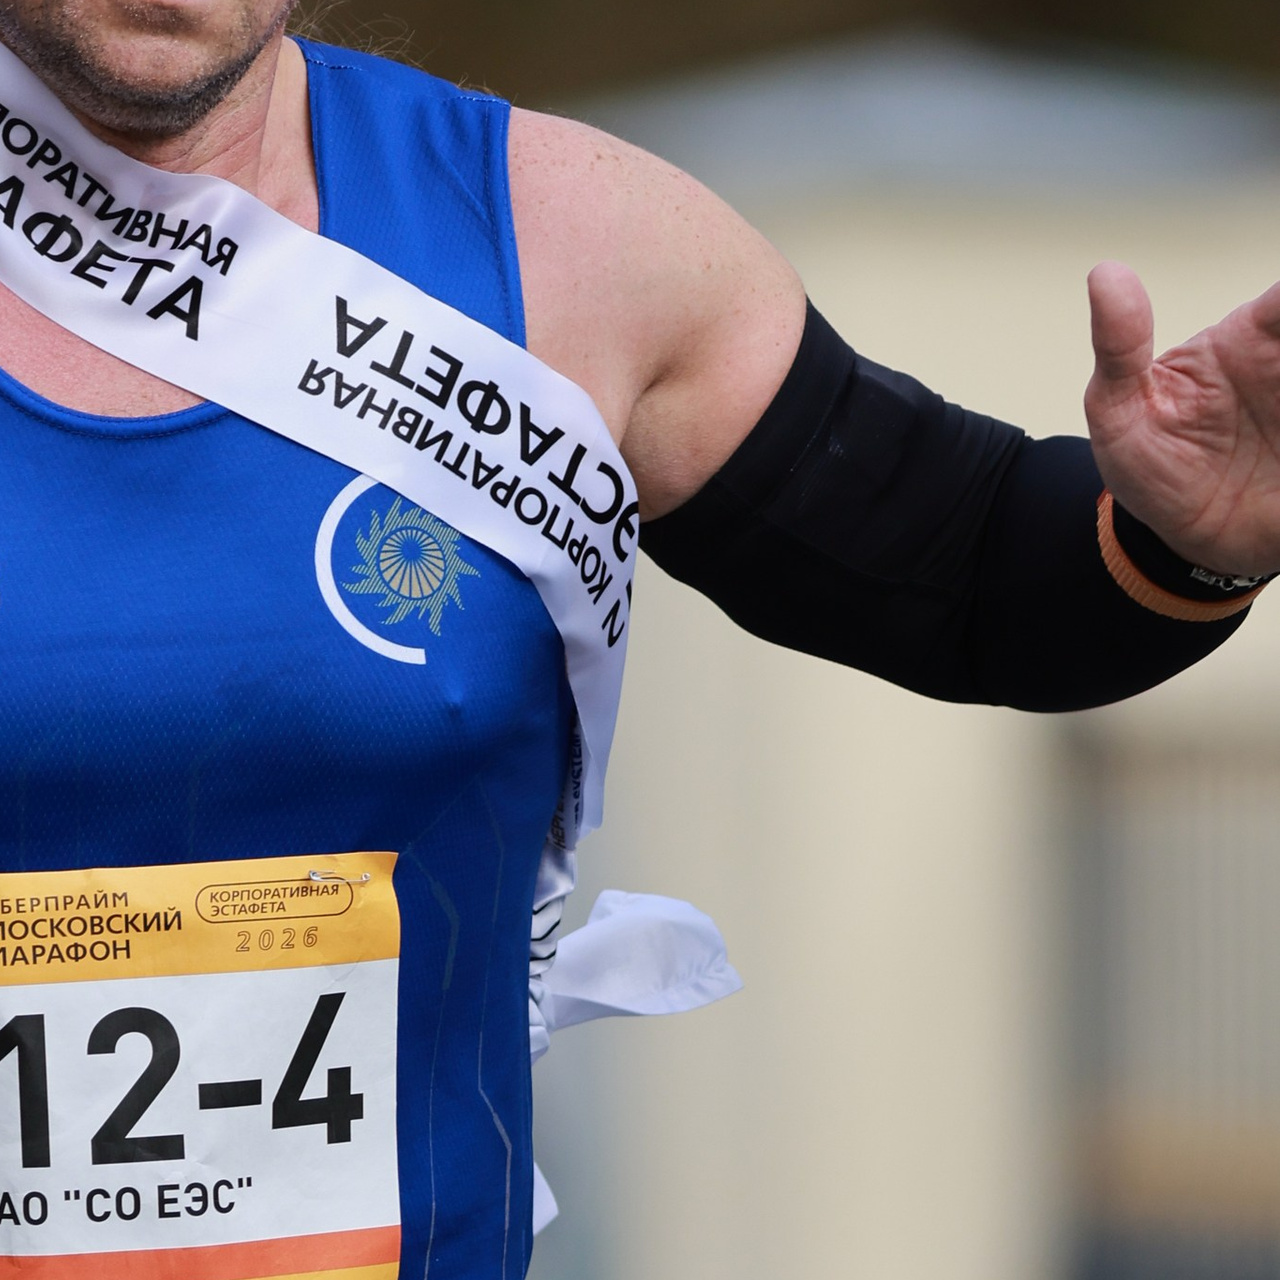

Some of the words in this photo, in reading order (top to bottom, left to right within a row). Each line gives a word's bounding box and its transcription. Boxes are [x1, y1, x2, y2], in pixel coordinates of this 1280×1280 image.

[336, 295, 640, 563] ЭСТАФЕТА
[298, 359, 613, 604] КОРПОРАТИВНАЯ
[210, 883, 340, 904] КОРПОРАТИВНАЯ
[210, 901, 286, 917] ЭСТАФЕТА
[235, 925, 319, 953] 2026
[64, 1186, 142, 1222] "СО
[157, 1177, 253, 1219] ЕЭС"
